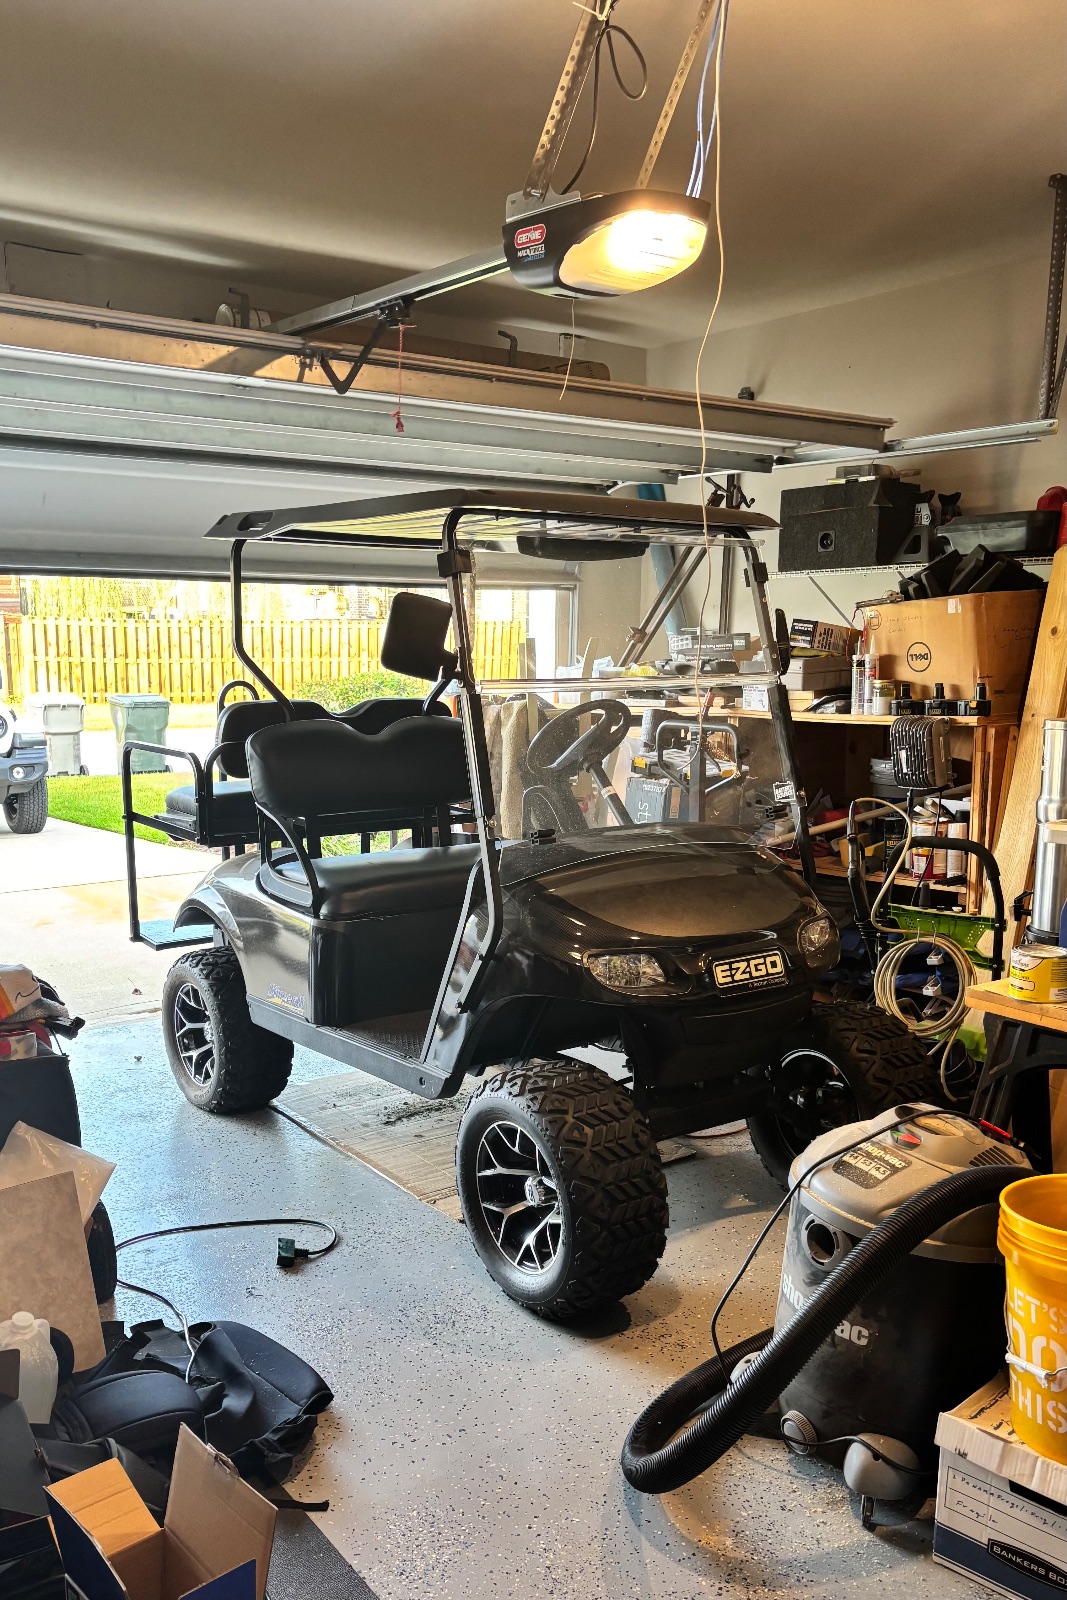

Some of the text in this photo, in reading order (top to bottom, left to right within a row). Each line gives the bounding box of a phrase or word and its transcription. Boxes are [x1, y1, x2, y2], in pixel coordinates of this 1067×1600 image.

[517, 229, 543, 243] GENIE
[909, 653, 929, 661] DELL
[782, 1273, 869, 1346] sho ac
[1007, 1278, 1067, 1335] LET'S
[1010, 1370, 1067, 1434] THIS
[993, 1545, 1067, 1586] BANKERS BO
